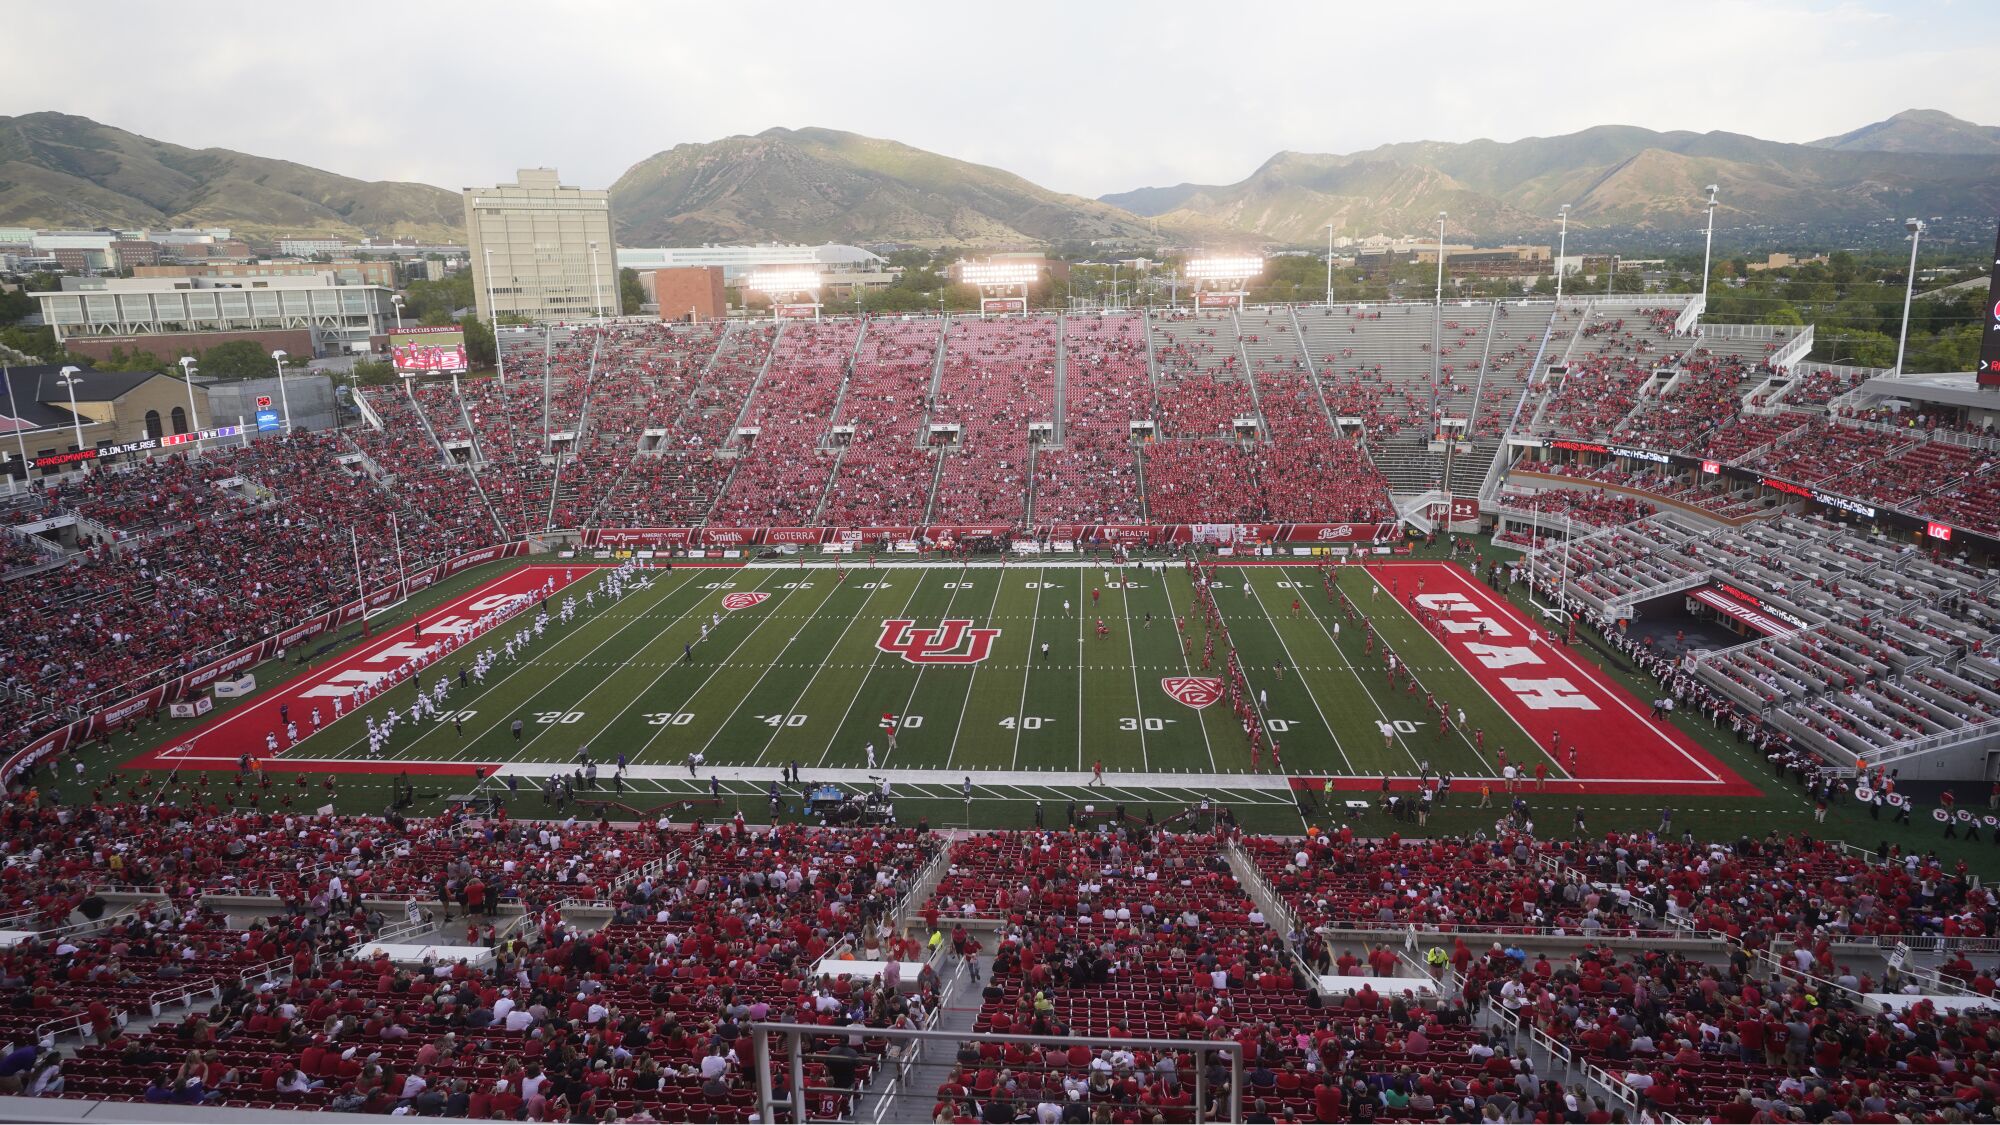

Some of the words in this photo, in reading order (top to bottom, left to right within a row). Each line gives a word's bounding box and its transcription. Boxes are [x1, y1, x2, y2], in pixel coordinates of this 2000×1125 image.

[258, 397, 269, 406] 25
[36, 449, 97, 467] RANSOMWARE
[46, 522, 56, 530] 24
[709, 530, 743, 542] Smith's
[452, 558, 467, 569] RED
[468, 551, 495, 564] ZONE
[1726, 604, 1764, 626] UTAH
[1415, 592, 1602, 711] UTAH
[189, 669, 218, 687] RED
[218, 654, 253, 674] ZONE
[1185, 692, 1208, 702] 12
[105, 698, 150, 723] University
[536, 711, 585, 724] 20
[648, 712, 695, 725] 30
[764, 714, 808, 727] 40
[879, 715, 924, 728] 50
[999, 716, 1042, 729] 40
[1119, 718, 1163, 731] 30
[1774, 1031, 1785, 1042] 15
[617, 1076, 628, 1089] 15
[821, 1100, 834, 1112] 19
[1359, 1103, 1373, 1118] 15
